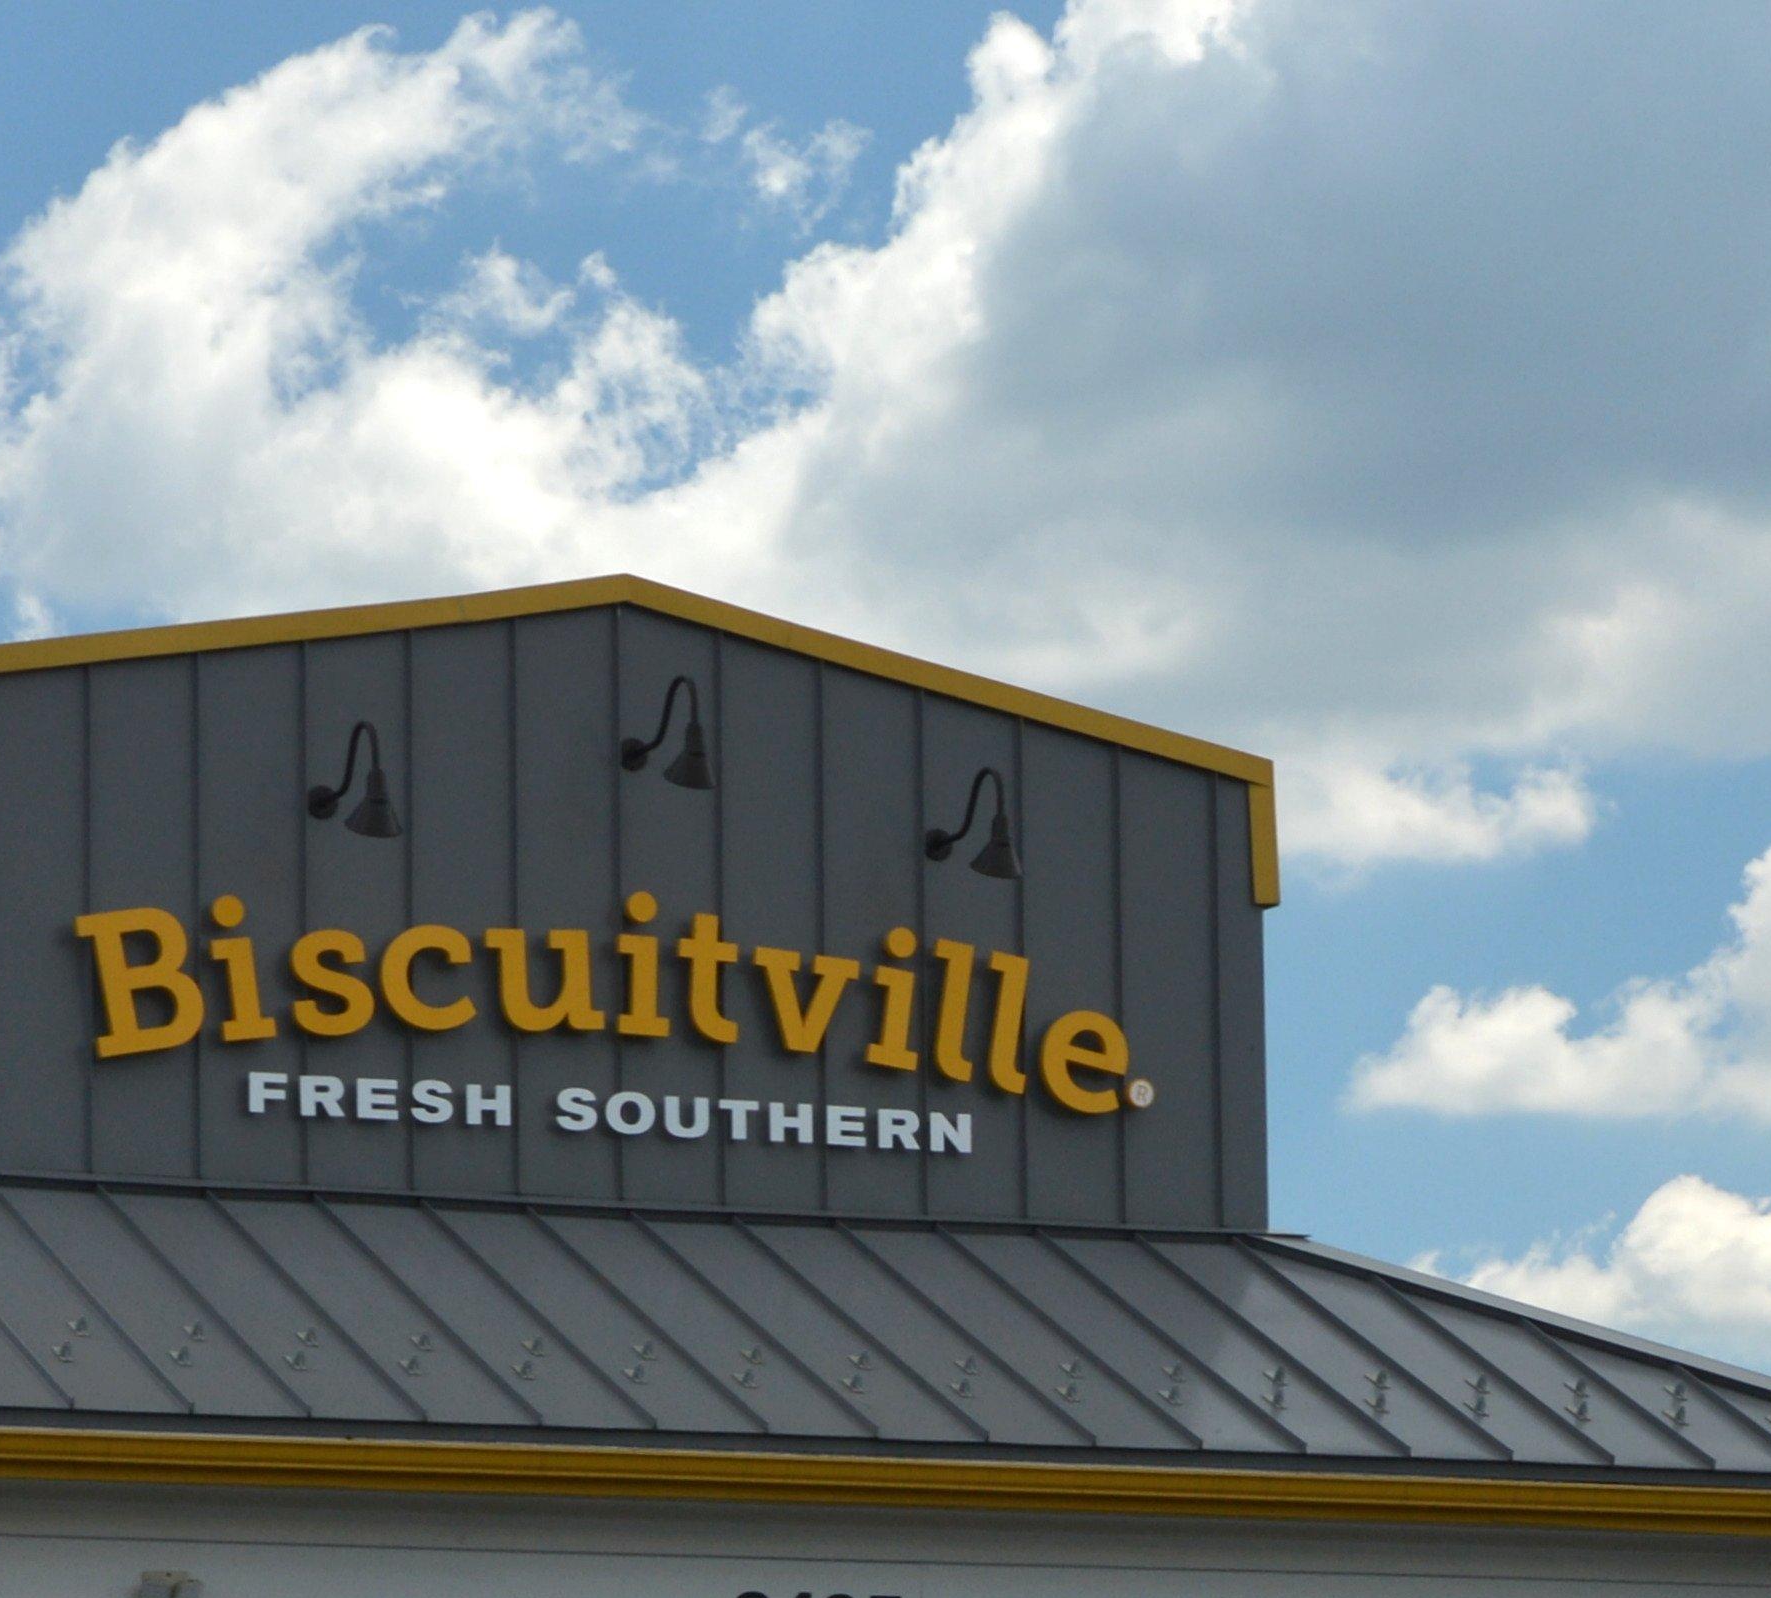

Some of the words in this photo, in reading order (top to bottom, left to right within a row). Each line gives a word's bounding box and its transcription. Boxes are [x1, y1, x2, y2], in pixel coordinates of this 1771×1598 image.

[74, 891, 1129, 1114] Biscuitville
[246, 1071, 514, 1127] FRESH
[555, 1086, 974, 1155] SOUTHERN
